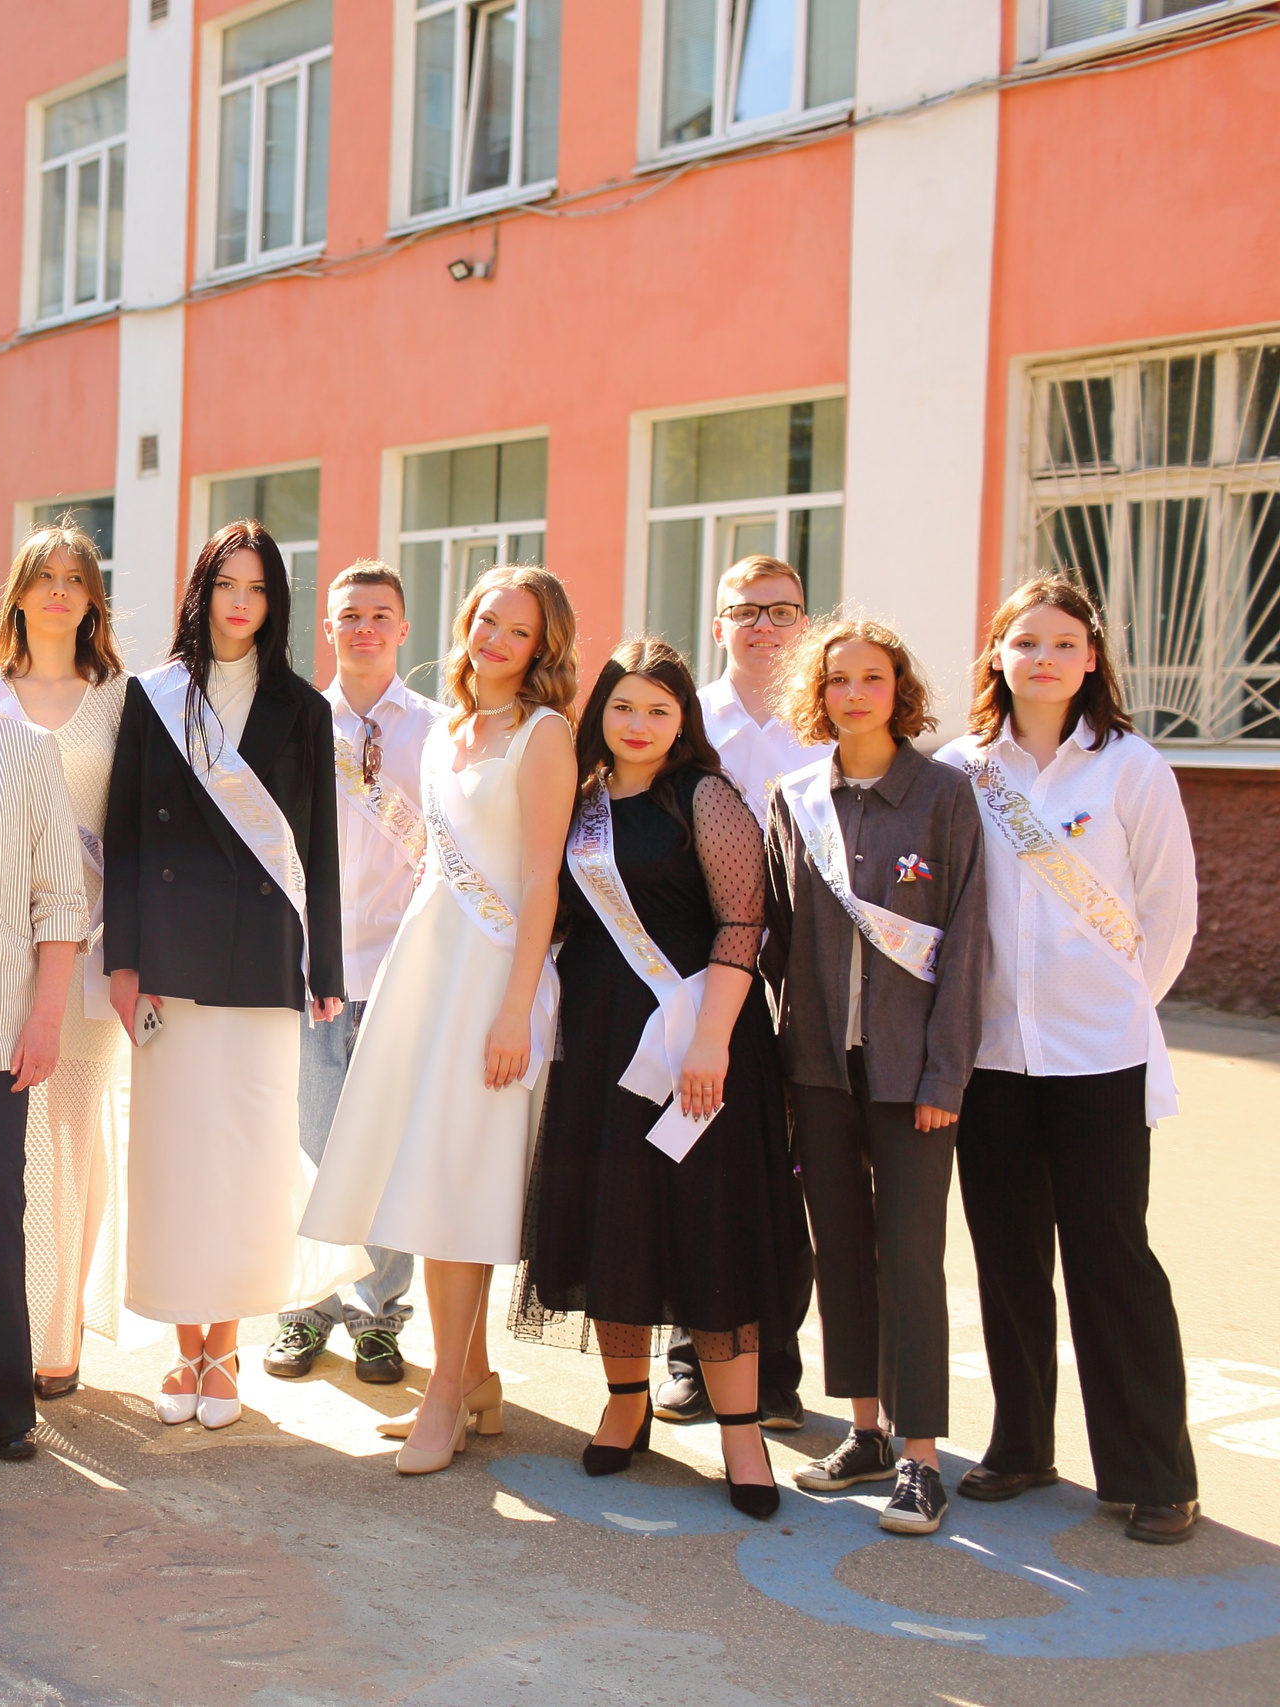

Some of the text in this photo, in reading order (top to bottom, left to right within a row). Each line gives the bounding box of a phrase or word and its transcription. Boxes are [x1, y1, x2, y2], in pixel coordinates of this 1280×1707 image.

[455, 872, 514, 934] 2024
[987, 790, 1144, 962] Выпускник 2024
